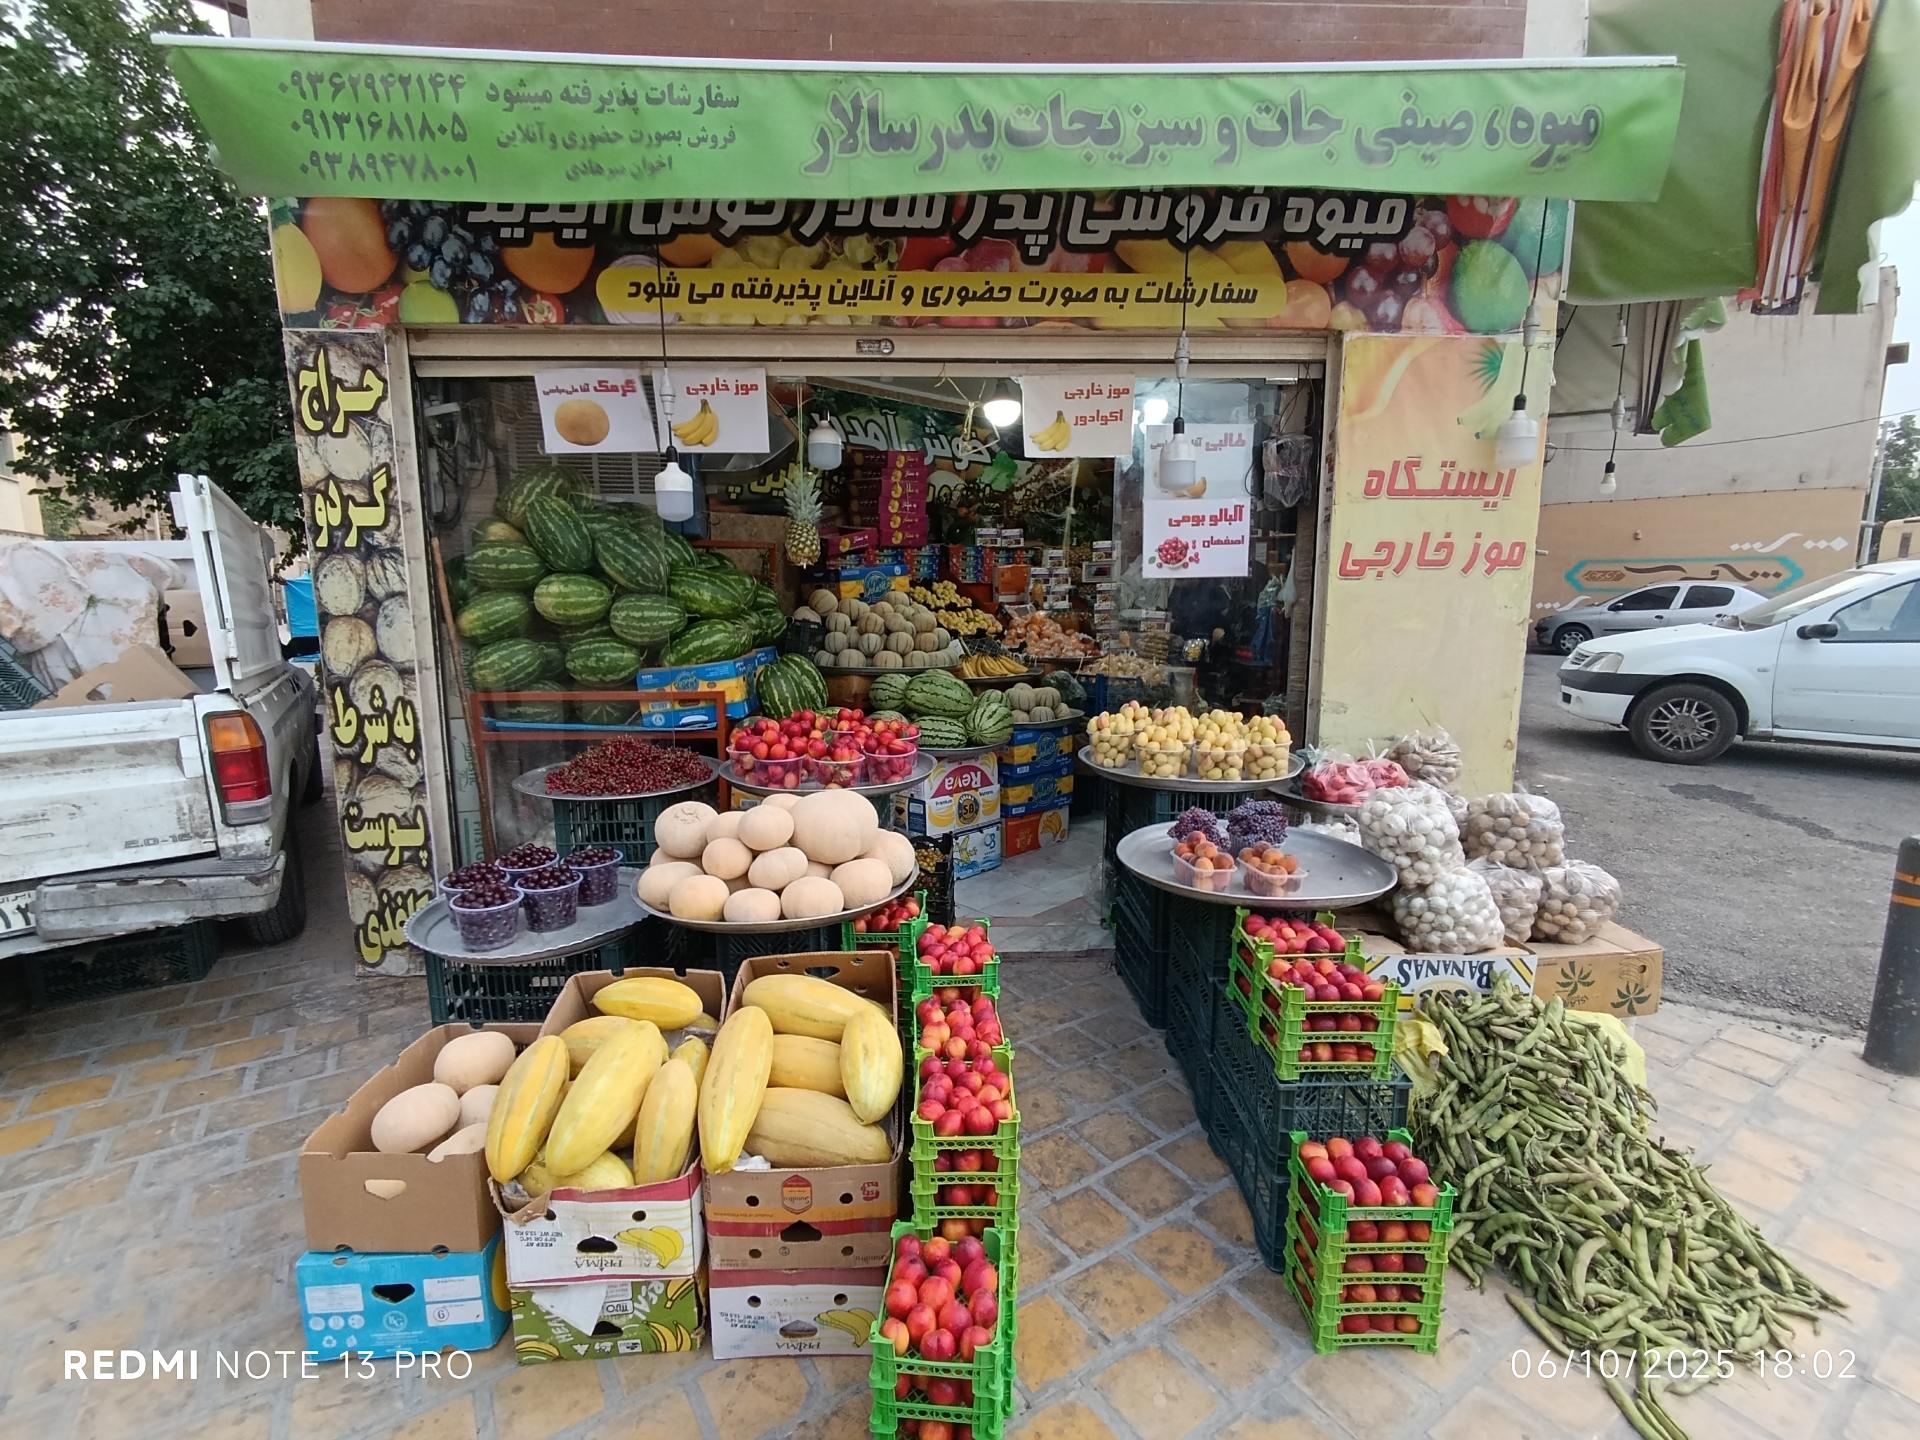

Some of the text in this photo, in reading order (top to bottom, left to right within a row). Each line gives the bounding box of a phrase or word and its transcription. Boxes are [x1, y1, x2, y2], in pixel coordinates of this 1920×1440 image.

[278, 70, 467, 103] ۰۹۳۶۲۹۴۲۱۴۴
[485, 78, 740, 115] سفارشات پذیرفته میشود
[291, 108, 468, 143] ۰۹۱۳۱۶۸۱۸۰۵
[562, 125, 624, 150] حضوری
[629, 127, 682, 148] بصورت
[687, 125, 736, 150] فروش
[802, 89, 918, 174] سالار
[917, 103, 995, 172] پدر
[1213, 115, 1239, 165] و
[1245, 89, 1345, 162] جات
[1354, 89, 1474, 166] صیفی
[300, 150, 478, 184] ۰۹۳۸۹۴۷۸۰۰۱
[958, 193, 1054, 256] پدر
[1066, 185, 1273, 246] فروشی
[1284, 196, 1408, 248] میوه
[627, 271, 1258, 311] سفارشات به صورت حضوری و آنلاین پذیرفته می شود
[299, 347, 385, 433] حراج
[593, 379, 637, 398] گرمک
[686, 377, 759, 396] موز خارجی
[1064, 382, 1130, 400] موز خارجی
[1073, 408, 1124, 427] اکوادور
[1205, 432, 1246, 452] طالبی
[1363, 456, 1517, 510] ایستگاه
[315, 467, 387, 548] گردو
[1168, 504, 1245, 528] آلبالو بومی
[1202, 535, 1245, 549] اصفهان
[1338, 531, 1527, 580] موز خارجی
[334, 686, 416, 764] به شرط
[944, 770, 983, 791] Reva
[344, 805, 425, 867] پوست
[1397, 958, 1496, 990] BANANAS
[574, 1259, 622, 1271] PRIMA
